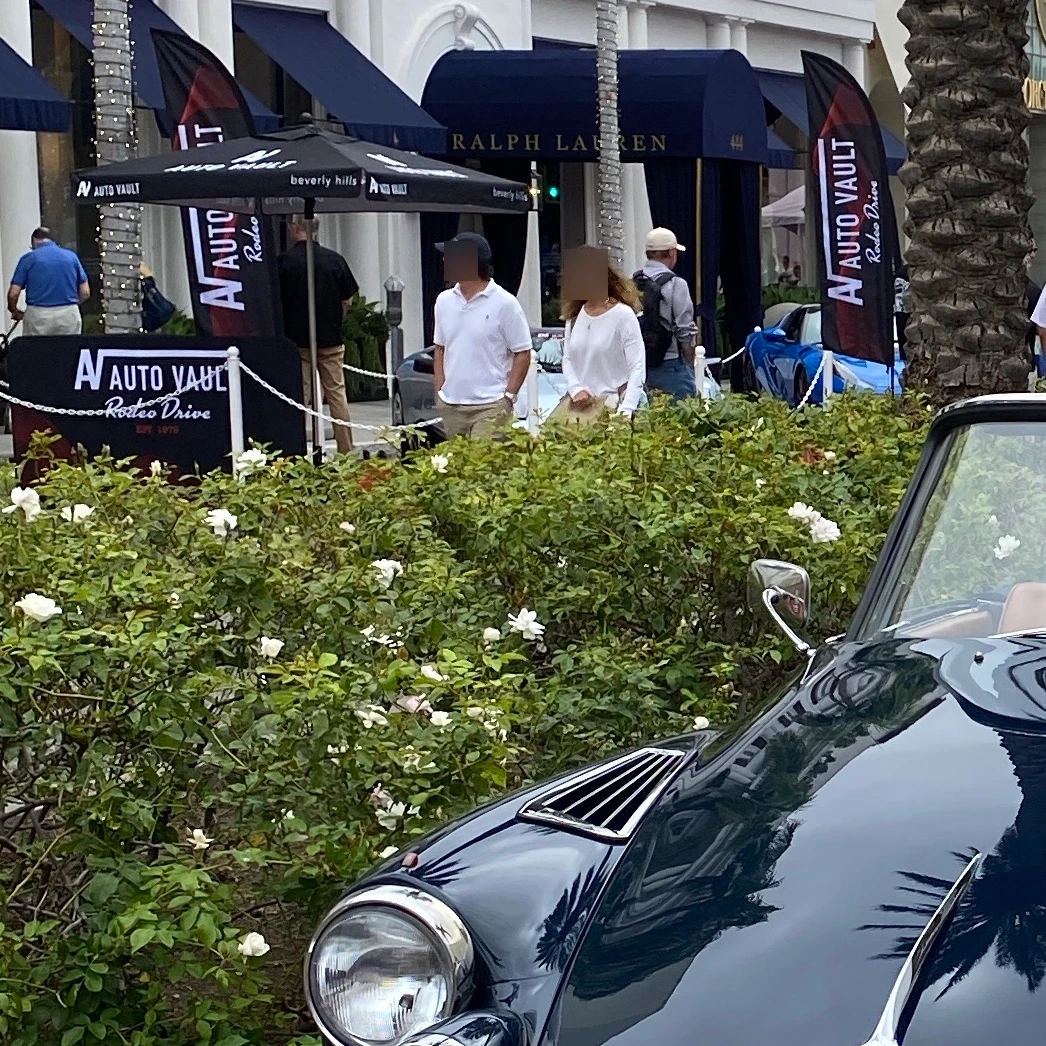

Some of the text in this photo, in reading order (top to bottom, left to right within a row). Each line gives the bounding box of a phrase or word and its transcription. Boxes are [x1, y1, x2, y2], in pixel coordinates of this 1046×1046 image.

[452, 133, 540, 151] RALPH
[93, 183, 115, 197] AUTO
[115, 182, 140, 195] VAULT
[290, 174, 357, 188] beverly hills
[831, 138, 858, 206] VAULT
[205, 209, 240, 270] AUTO
[241, 216, 264, 263] Rodeo
[863, 180, 882, 264] Rodeo Drive
[835, 213, 862, 270] AUTO
[109, 364, 164, 391] AUTO
[171, 365, 228, 392] VAUL
[105, 395, 211, 420] Rodeo Drive
